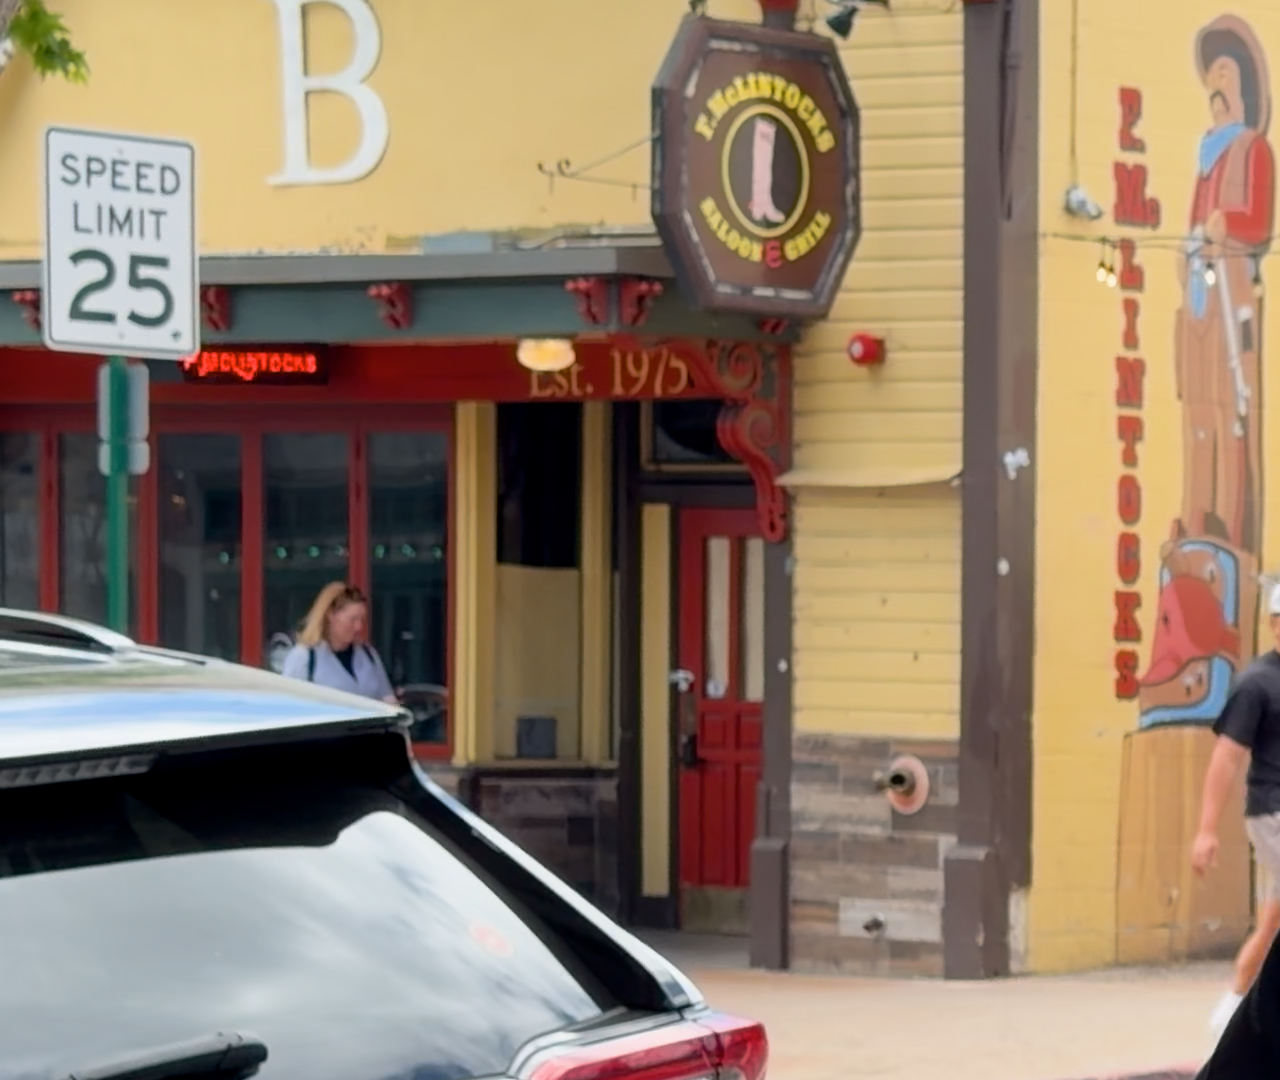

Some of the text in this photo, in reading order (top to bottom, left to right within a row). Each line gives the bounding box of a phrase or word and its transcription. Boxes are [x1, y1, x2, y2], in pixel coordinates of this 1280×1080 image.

[264, 0, 390, 187] B
[60, 152, 181, 197] SPEED
[73, 200, 168, 242] LIMIT
[699, 195, 763, 262] SALOON
[784, 210, 832, 262] GRILL
[68, 248, 175, 328] 25
[610, 346, 689, 397] 1975
